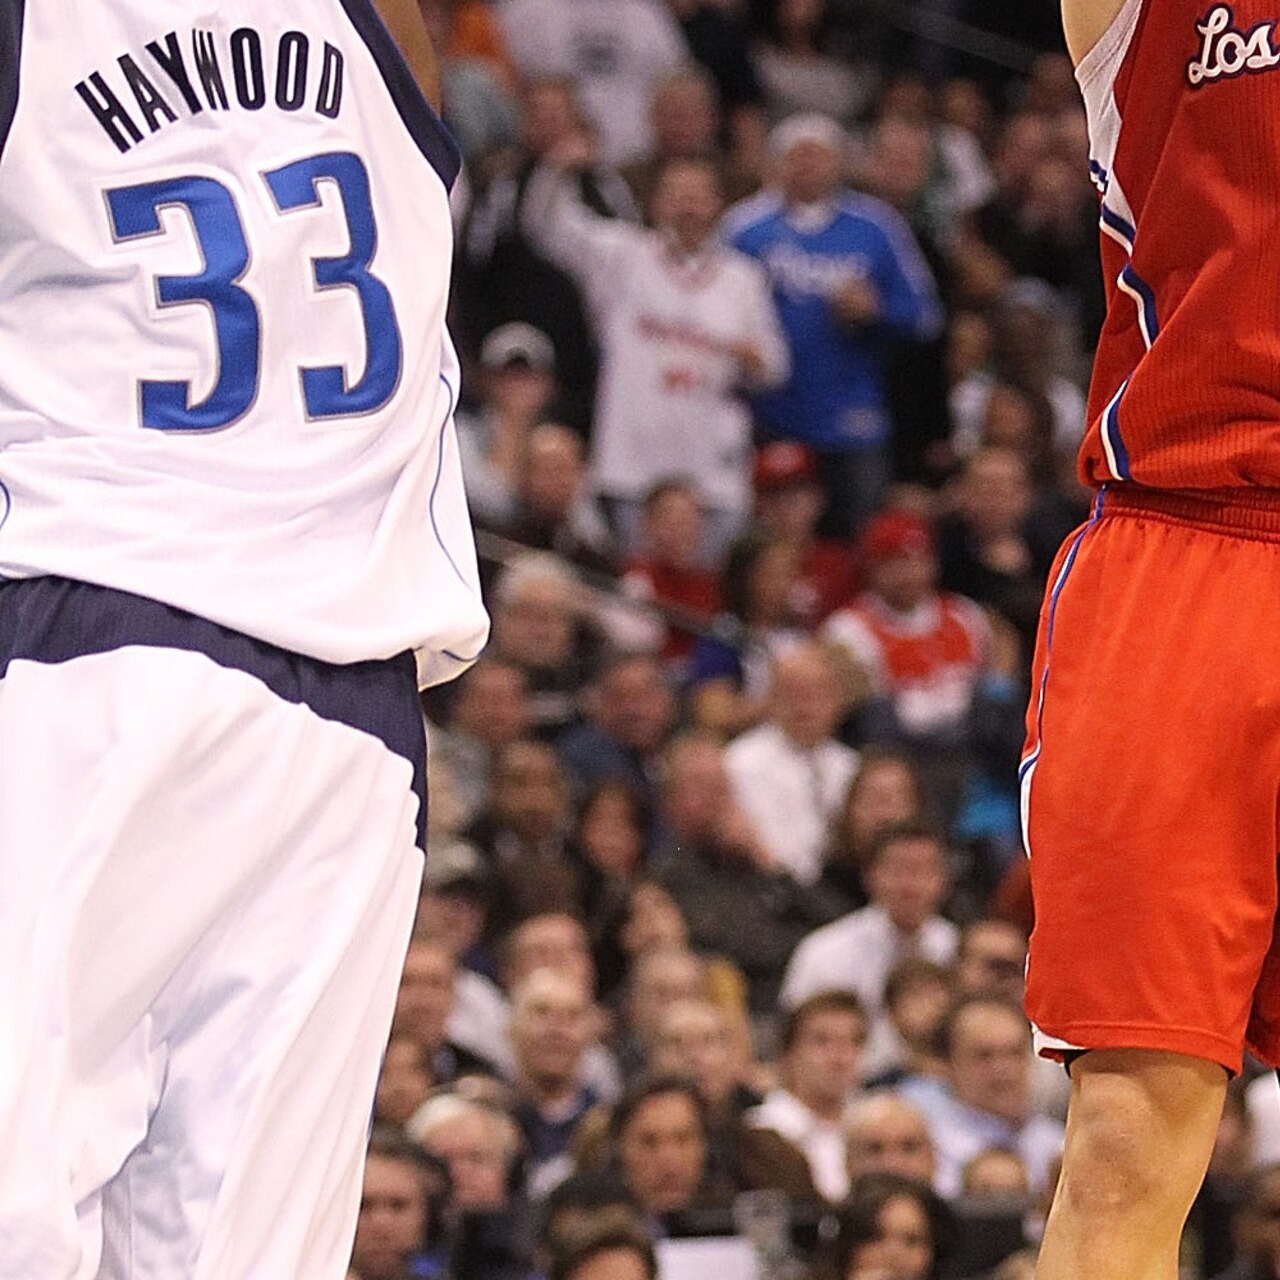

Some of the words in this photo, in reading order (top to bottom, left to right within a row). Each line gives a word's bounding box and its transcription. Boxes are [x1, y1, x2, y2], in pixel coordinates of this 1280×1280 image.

[75, 27, 344, 154] HAYWOOD
[1187, 5, 1280, 85] Los
[102, 151, 403, 435] 33
